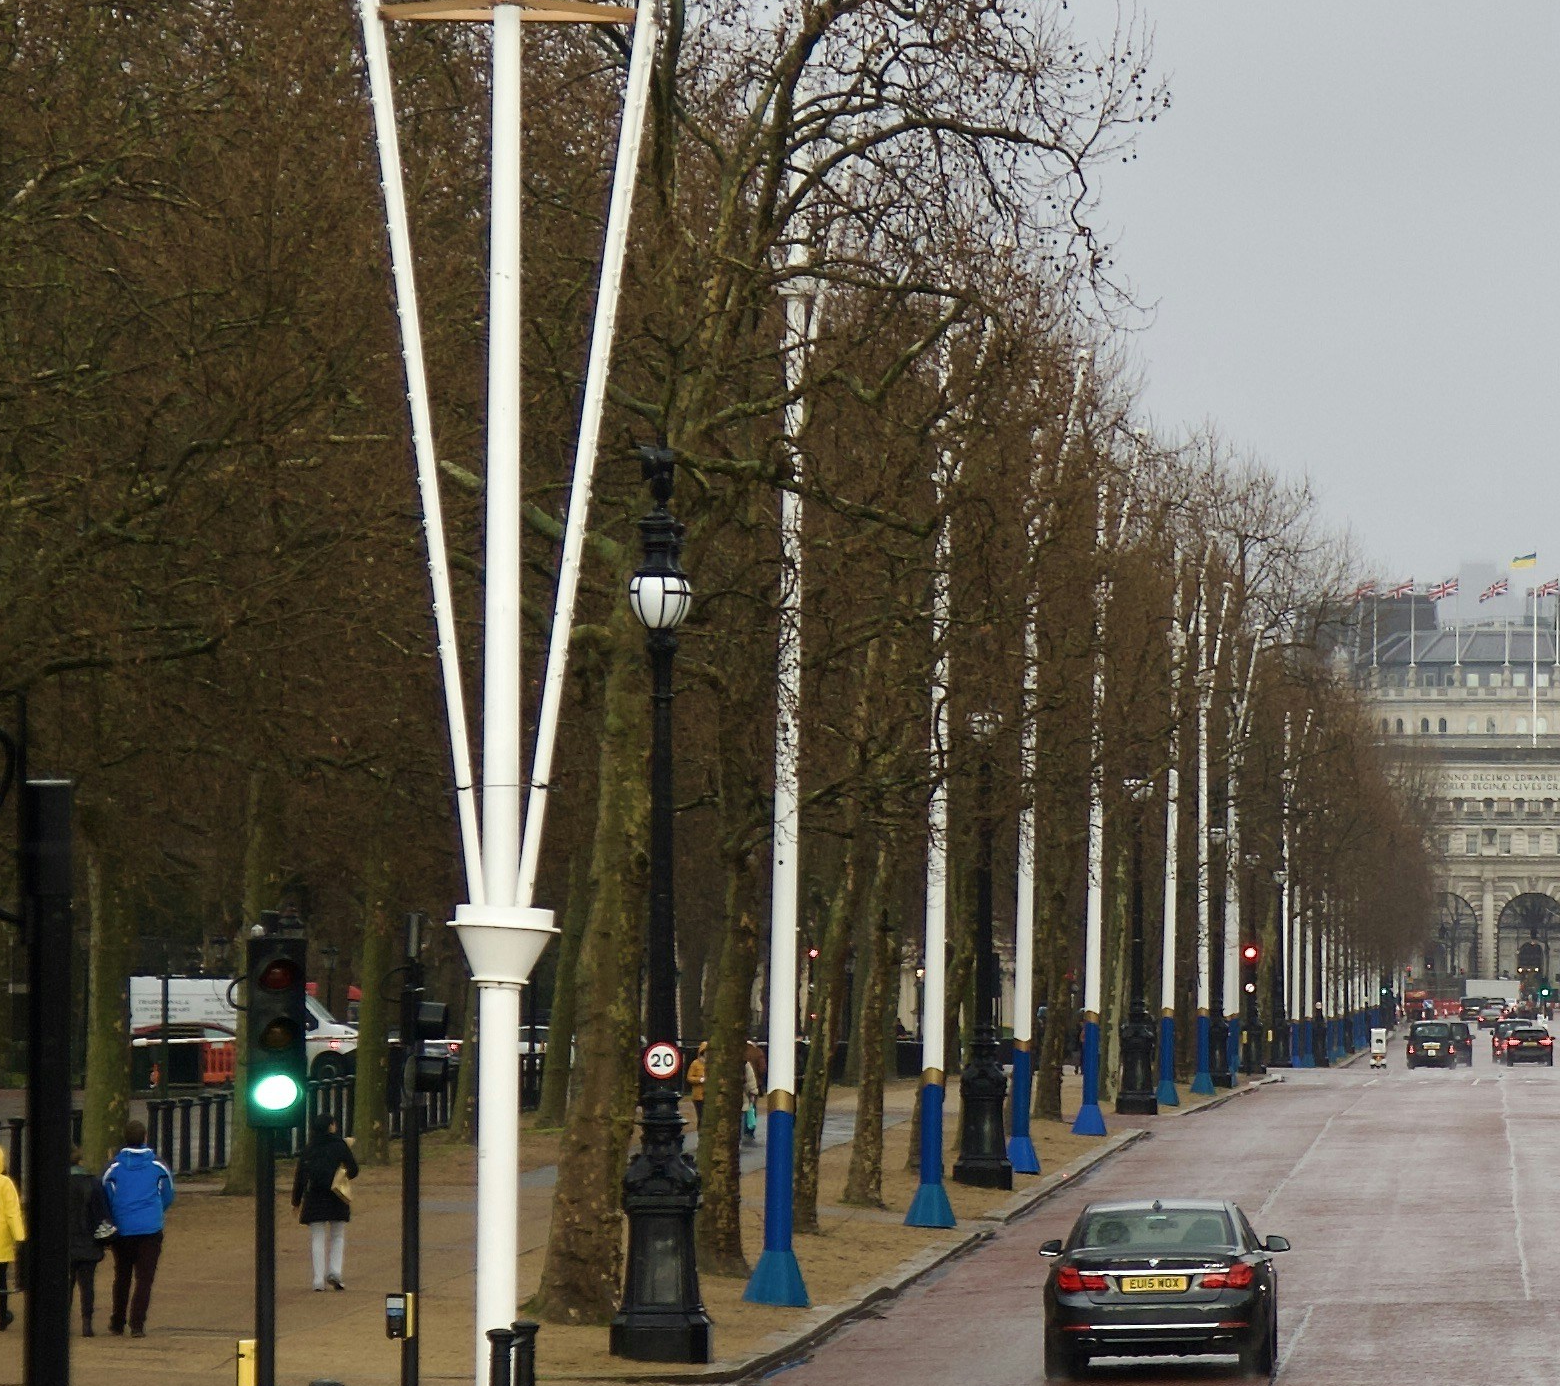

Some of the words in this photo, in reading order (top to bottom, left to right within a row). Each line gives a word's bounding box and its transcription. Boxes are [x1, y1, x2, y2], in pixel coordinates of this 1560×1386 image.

[1440, 773, 1469, 782] ANNO
[1472, 773, 1511, 782] DECIMO
[1514, 773, 1557, 782] EDWARDI
[1512, 782, 1542, 791] CIVES
[650, 1053, 675, 1068] 20
[1129, 1277, 1155, 1289] EU15
